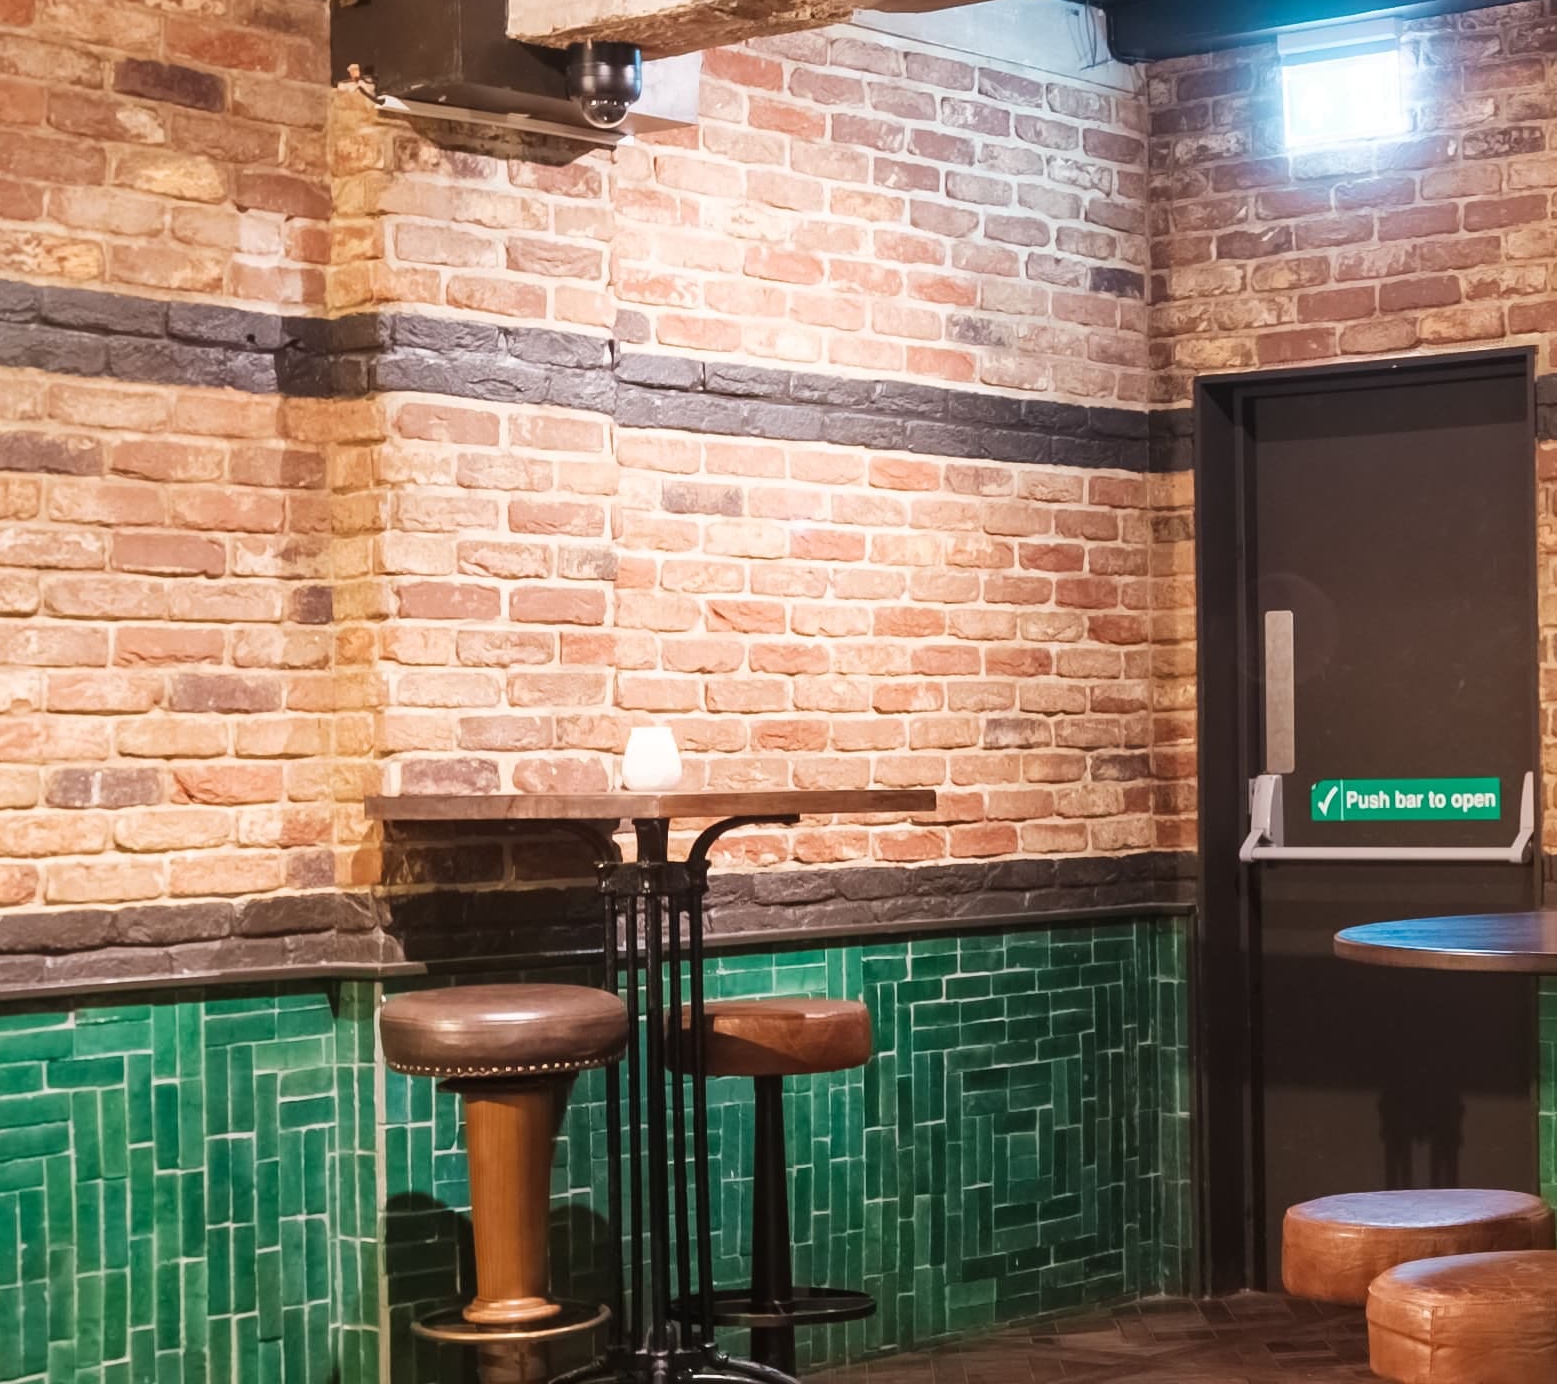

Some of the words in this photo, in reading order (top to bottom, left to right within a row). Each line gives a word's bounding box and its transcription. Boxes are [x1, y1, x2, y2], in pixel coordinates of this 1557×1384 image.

[1346, 791, 1390, 809] Push
[1395, 790, 1424, 809] bar
[1428, 791, 1446, 808] to
[1451, 792, 1496, 813] open
